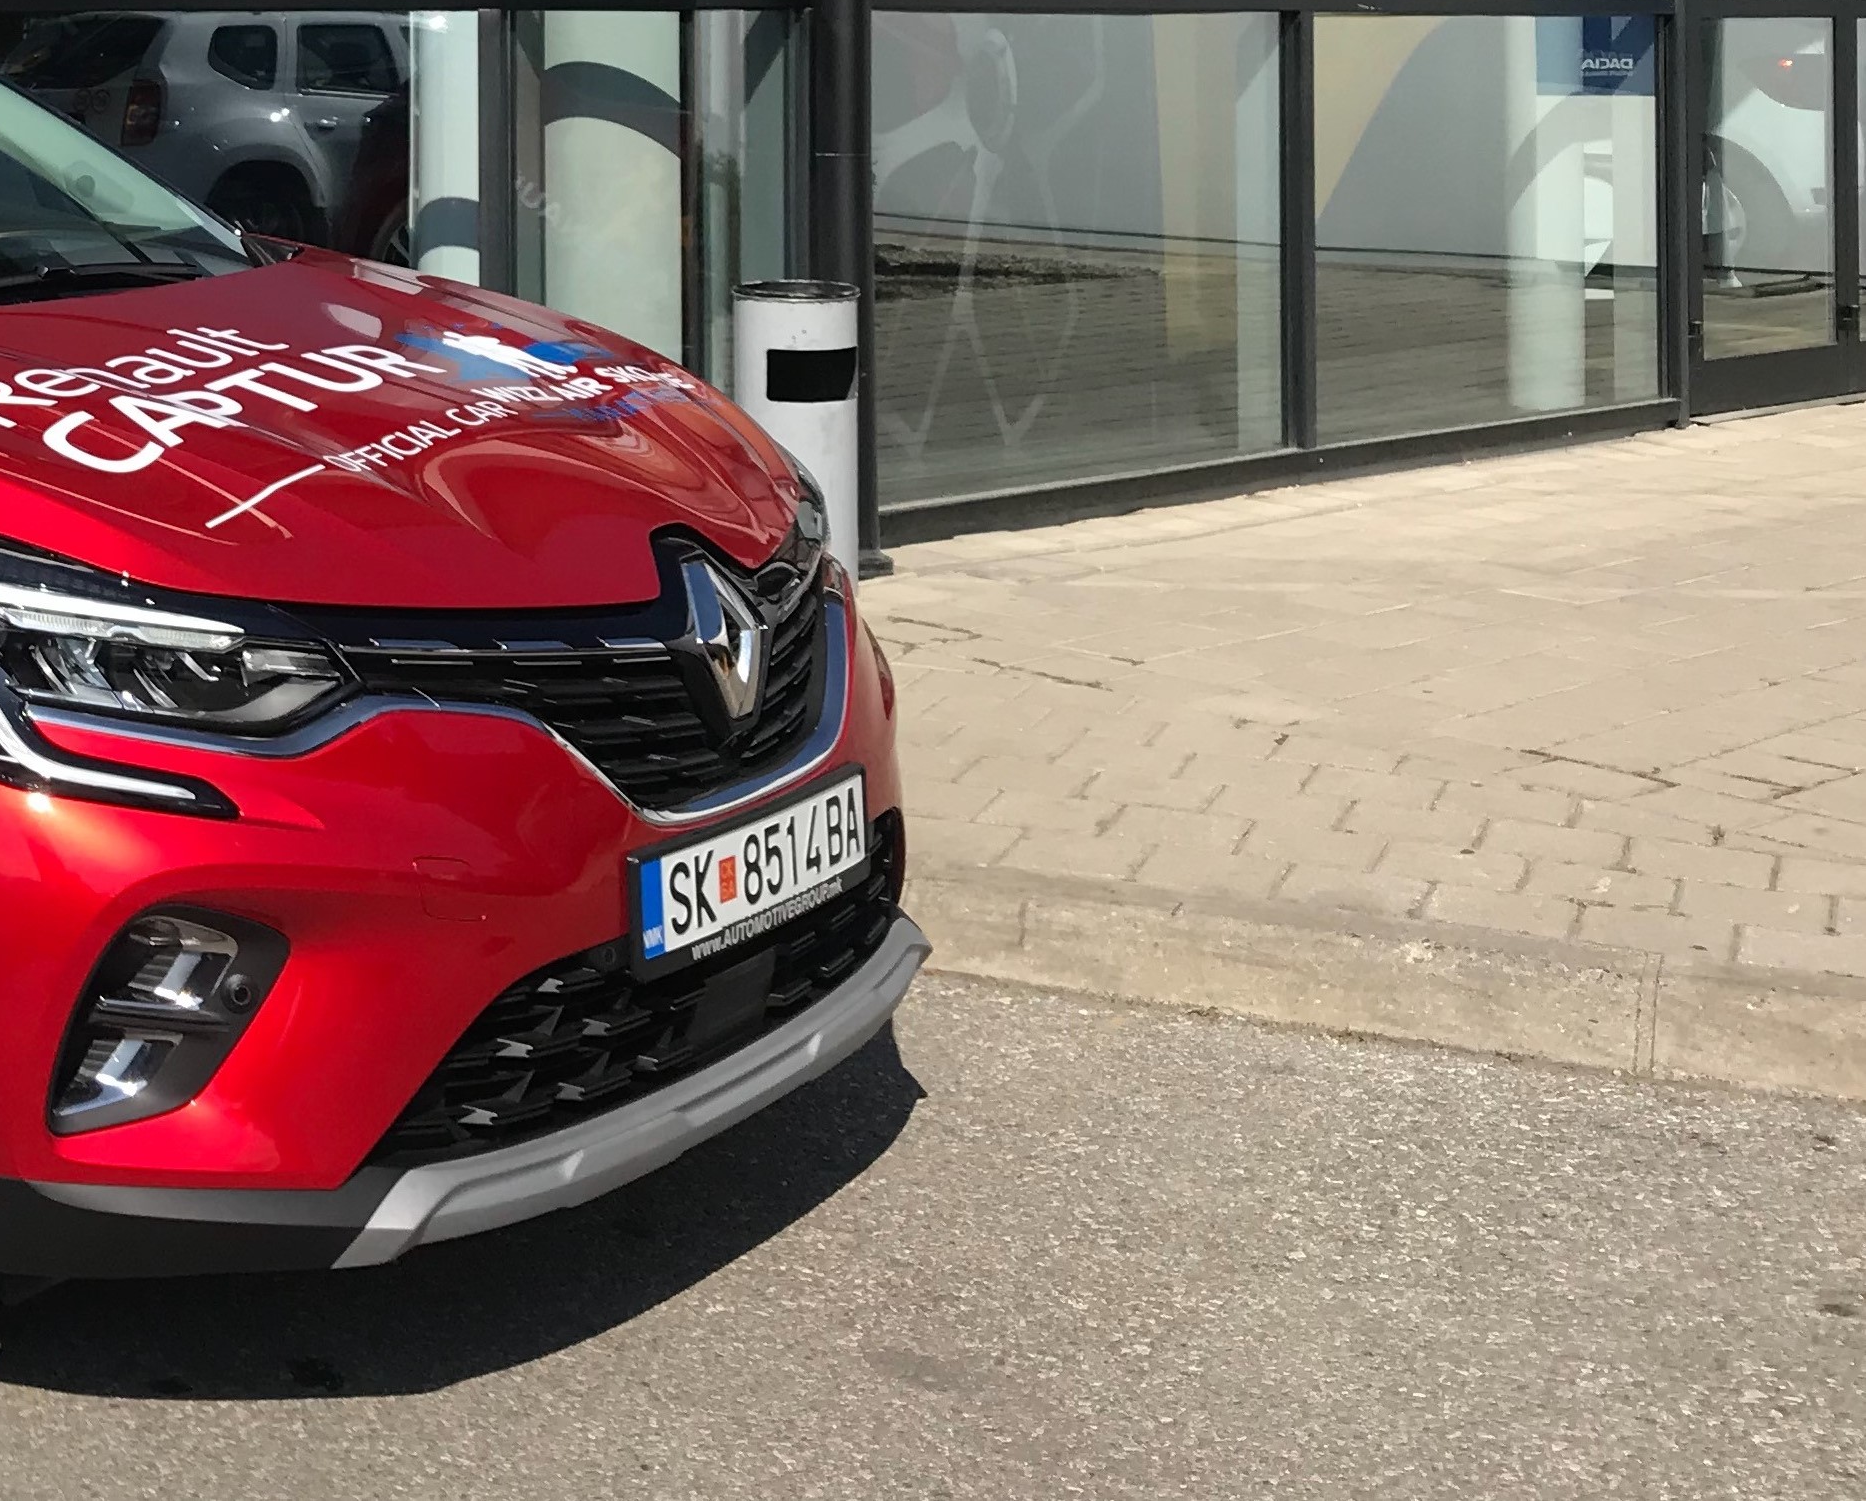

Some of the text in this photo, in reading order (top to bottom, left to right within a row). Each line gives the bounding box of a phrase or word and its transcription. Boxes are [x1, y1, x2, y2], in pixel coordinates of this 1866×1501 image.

[42, 343, 447, 474] CAPTUR
[549, 375, 614, 403] AIR
[324, 419, 463, 473] OFFICIAL
[446, 399, 519, 427] CAR
[669, 850, 717, 935] SK
